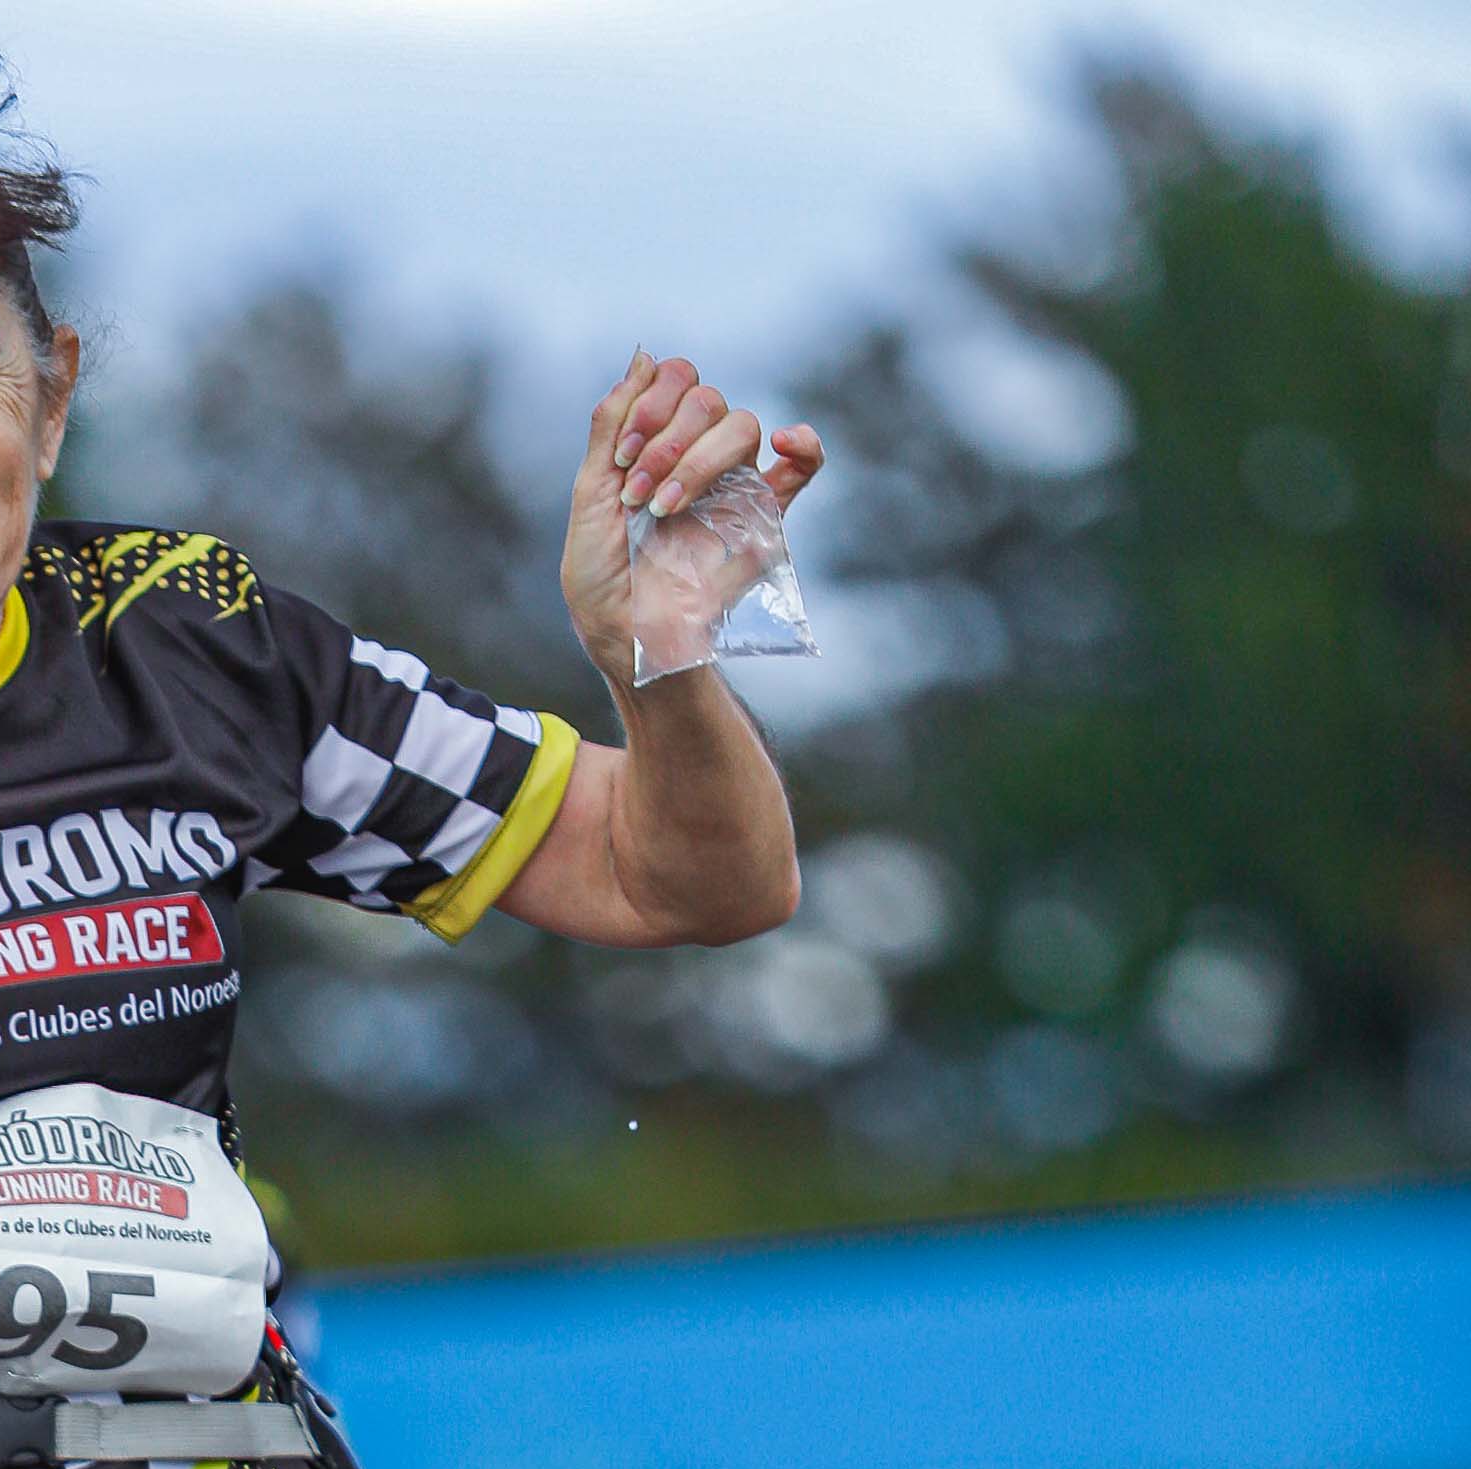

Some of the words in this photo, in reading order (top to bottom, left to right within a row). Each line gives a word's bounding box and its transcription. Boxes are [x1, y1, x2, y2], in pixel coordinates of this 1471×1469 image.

[63, 905, 190, 966] RACE
[8, 1004, 113, 1043] Clubes
[119, 990, 165, 1025] del
[96, 1174, 163, 1212] RACE
[14, 1217, 34, 1234] de
[38, 1218, 60, 1235] los
[64, 1218, 116, 1238] Clubes
[119, 1223, 143, 1240] del
[146, 1226, 212, 1244] Noroeste
